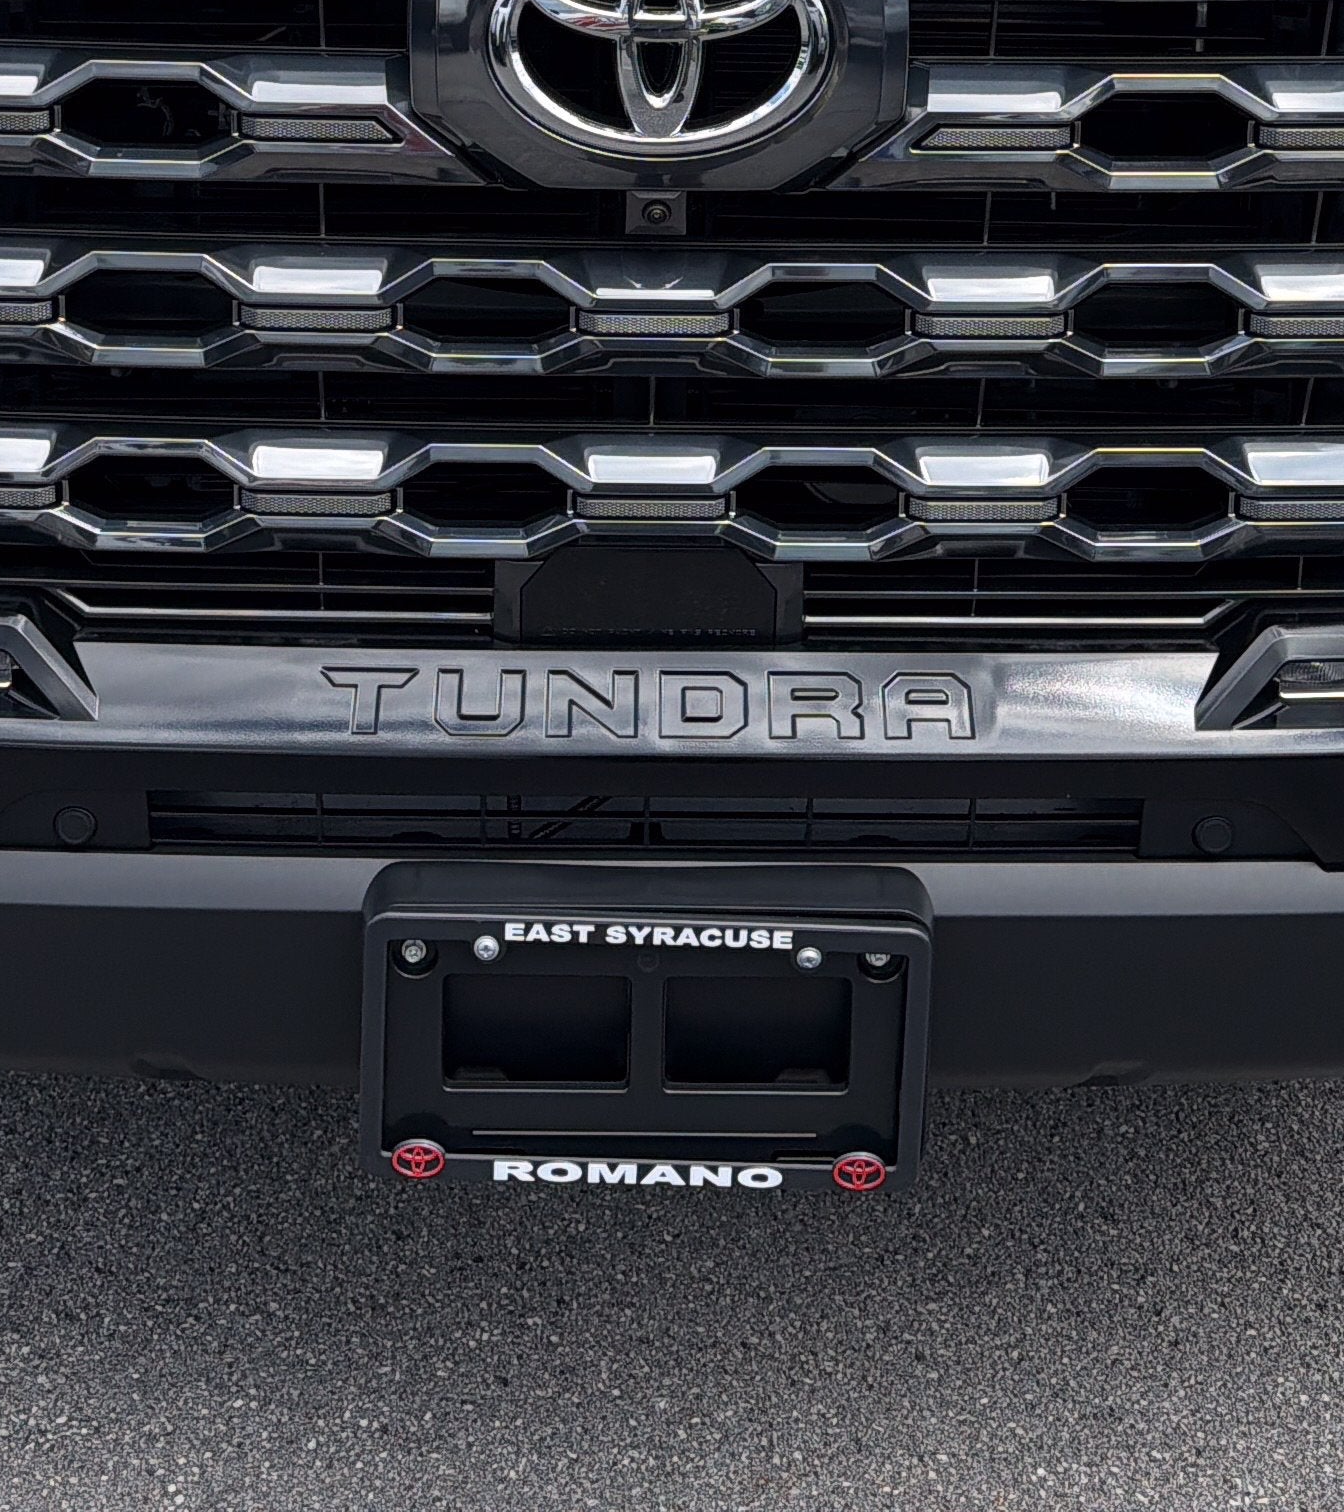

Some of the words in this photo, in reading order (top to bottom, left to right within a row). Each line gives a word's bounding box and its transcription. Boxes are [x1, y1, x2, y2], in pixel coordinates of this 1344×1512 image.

[319, 665, 977, 740] TUNDRA
[504, 922, 596, 944] EAST
[605, 924, 794, 950] SYRACUSE
[493, 1160, 784, 1189] ROMANO
